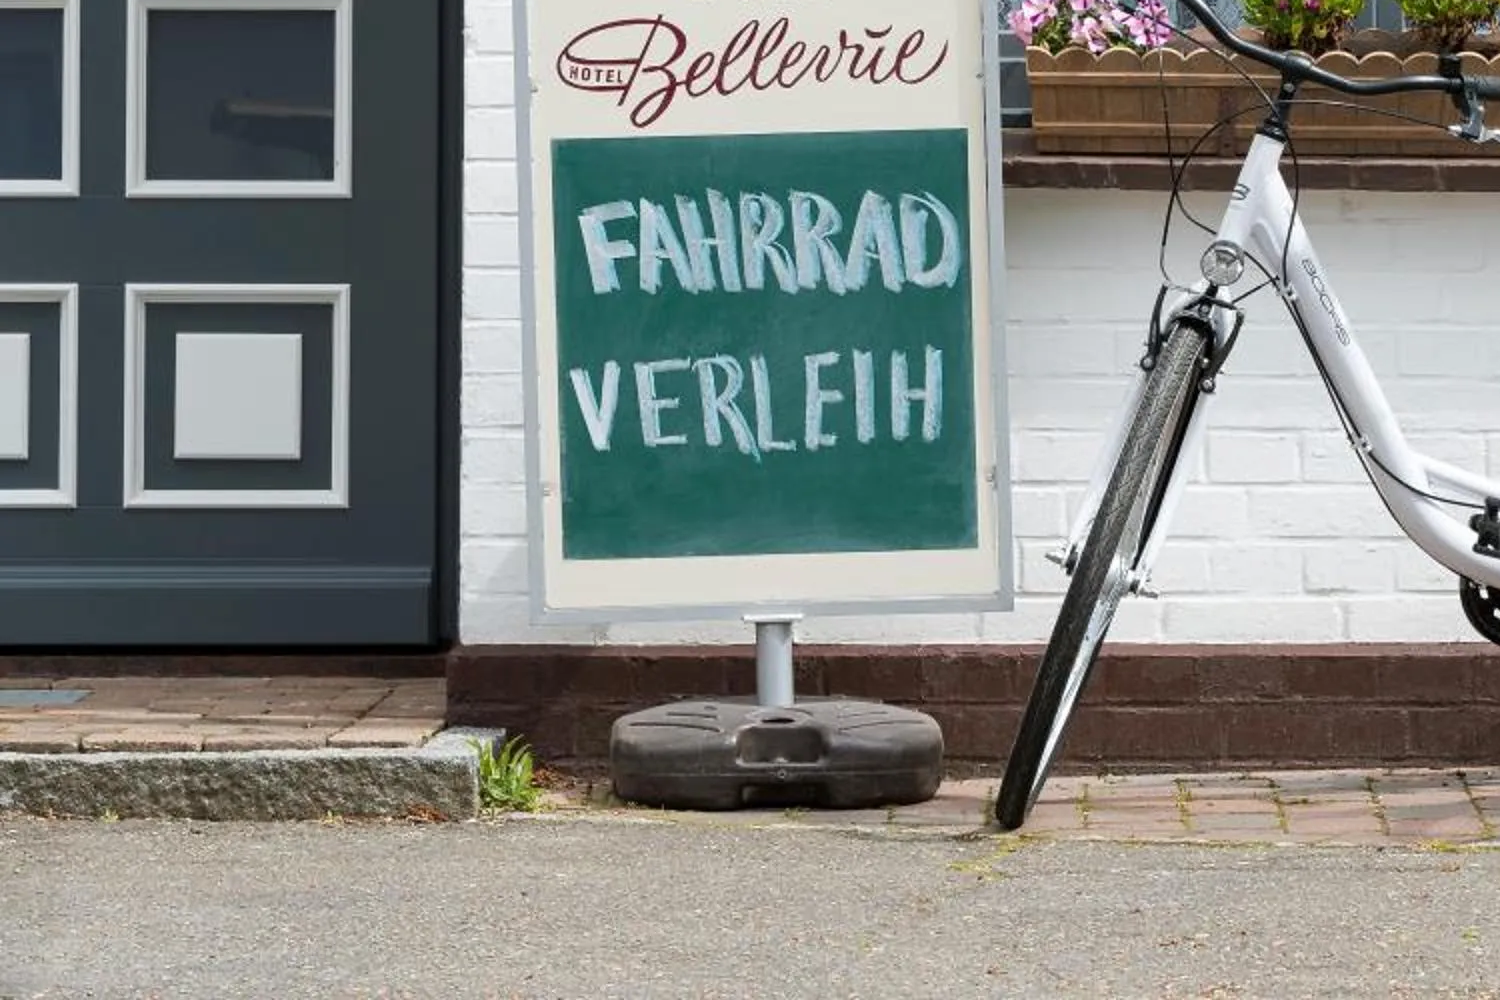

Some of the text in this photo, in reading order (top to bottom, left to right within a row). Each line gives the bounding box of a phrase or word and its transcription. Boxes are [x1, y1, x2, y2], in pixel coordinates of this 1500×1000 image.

[568, 65, 625, 84] HOTEL
[578, 187, 961, 295] FAHRRAD
[569, 344, 944, 463] VERLEIH
